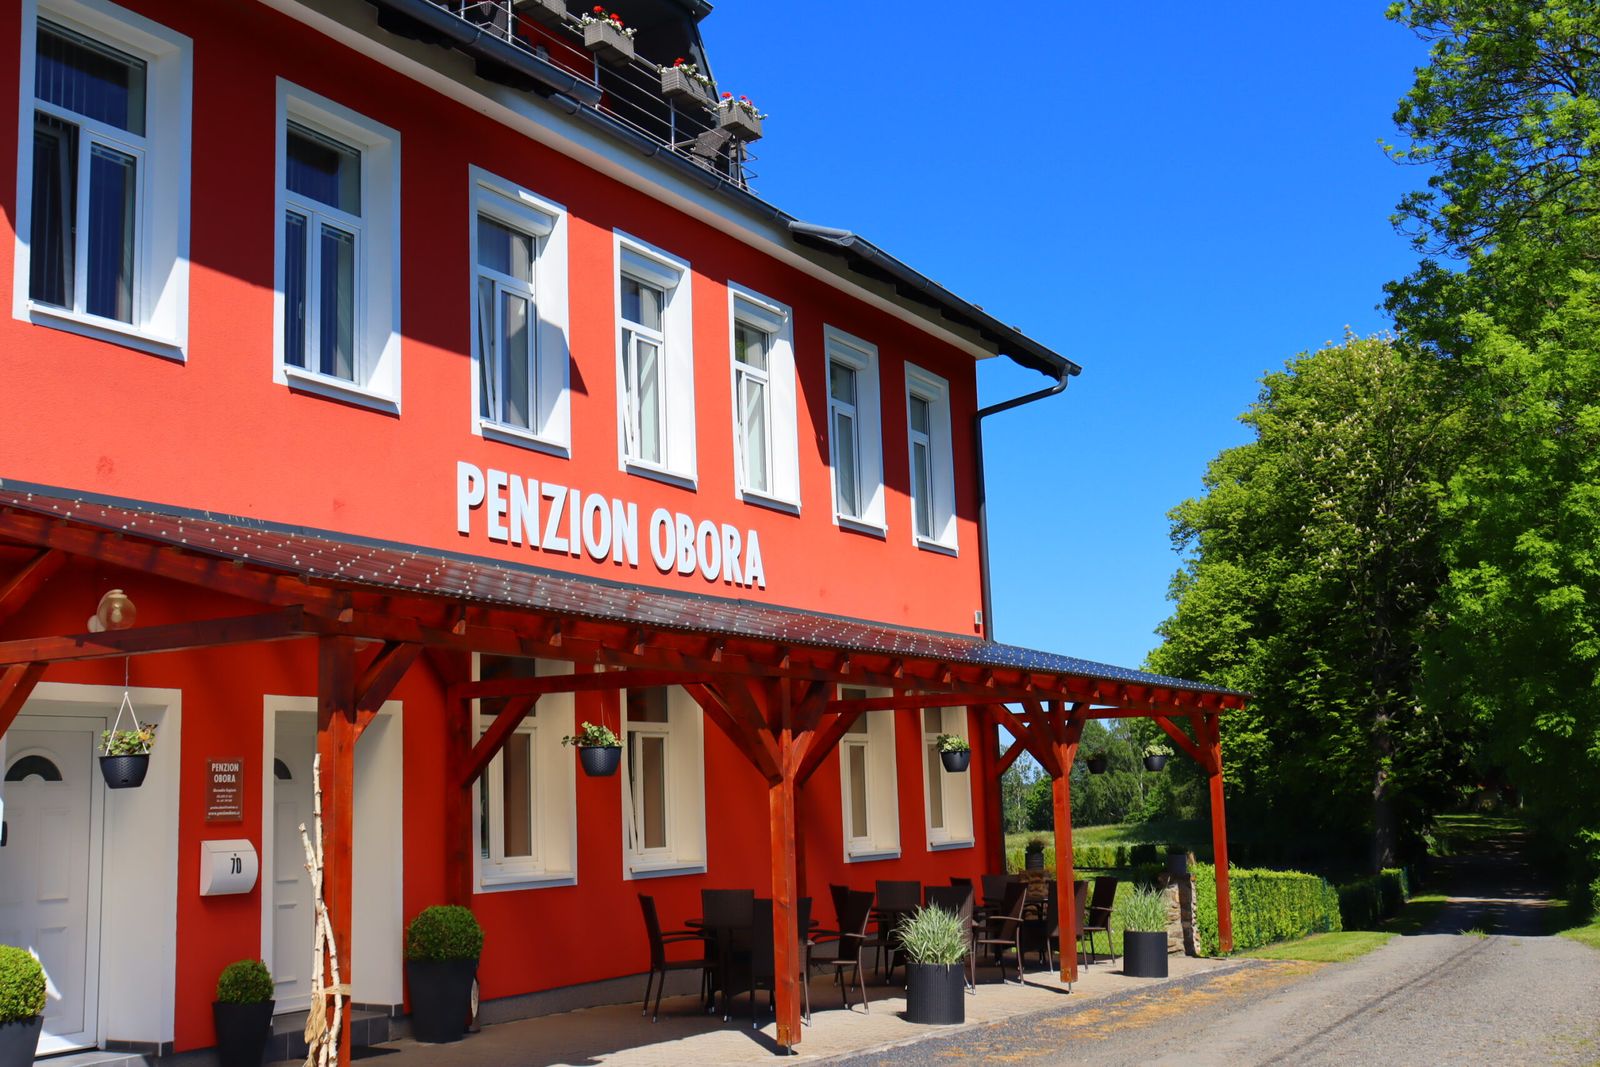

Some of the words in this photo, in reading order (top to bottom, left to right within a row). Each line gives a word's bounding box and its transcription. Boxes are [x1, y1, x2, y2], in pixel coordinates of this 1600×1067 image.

[457, 461, 638, 568] PENZION
[650, 508, 766, 590] OBORA
[211, 762, 239, 772] PENZION
[213, 774, 236, 783] OBORA
[230, 857, 242, 874] 70
